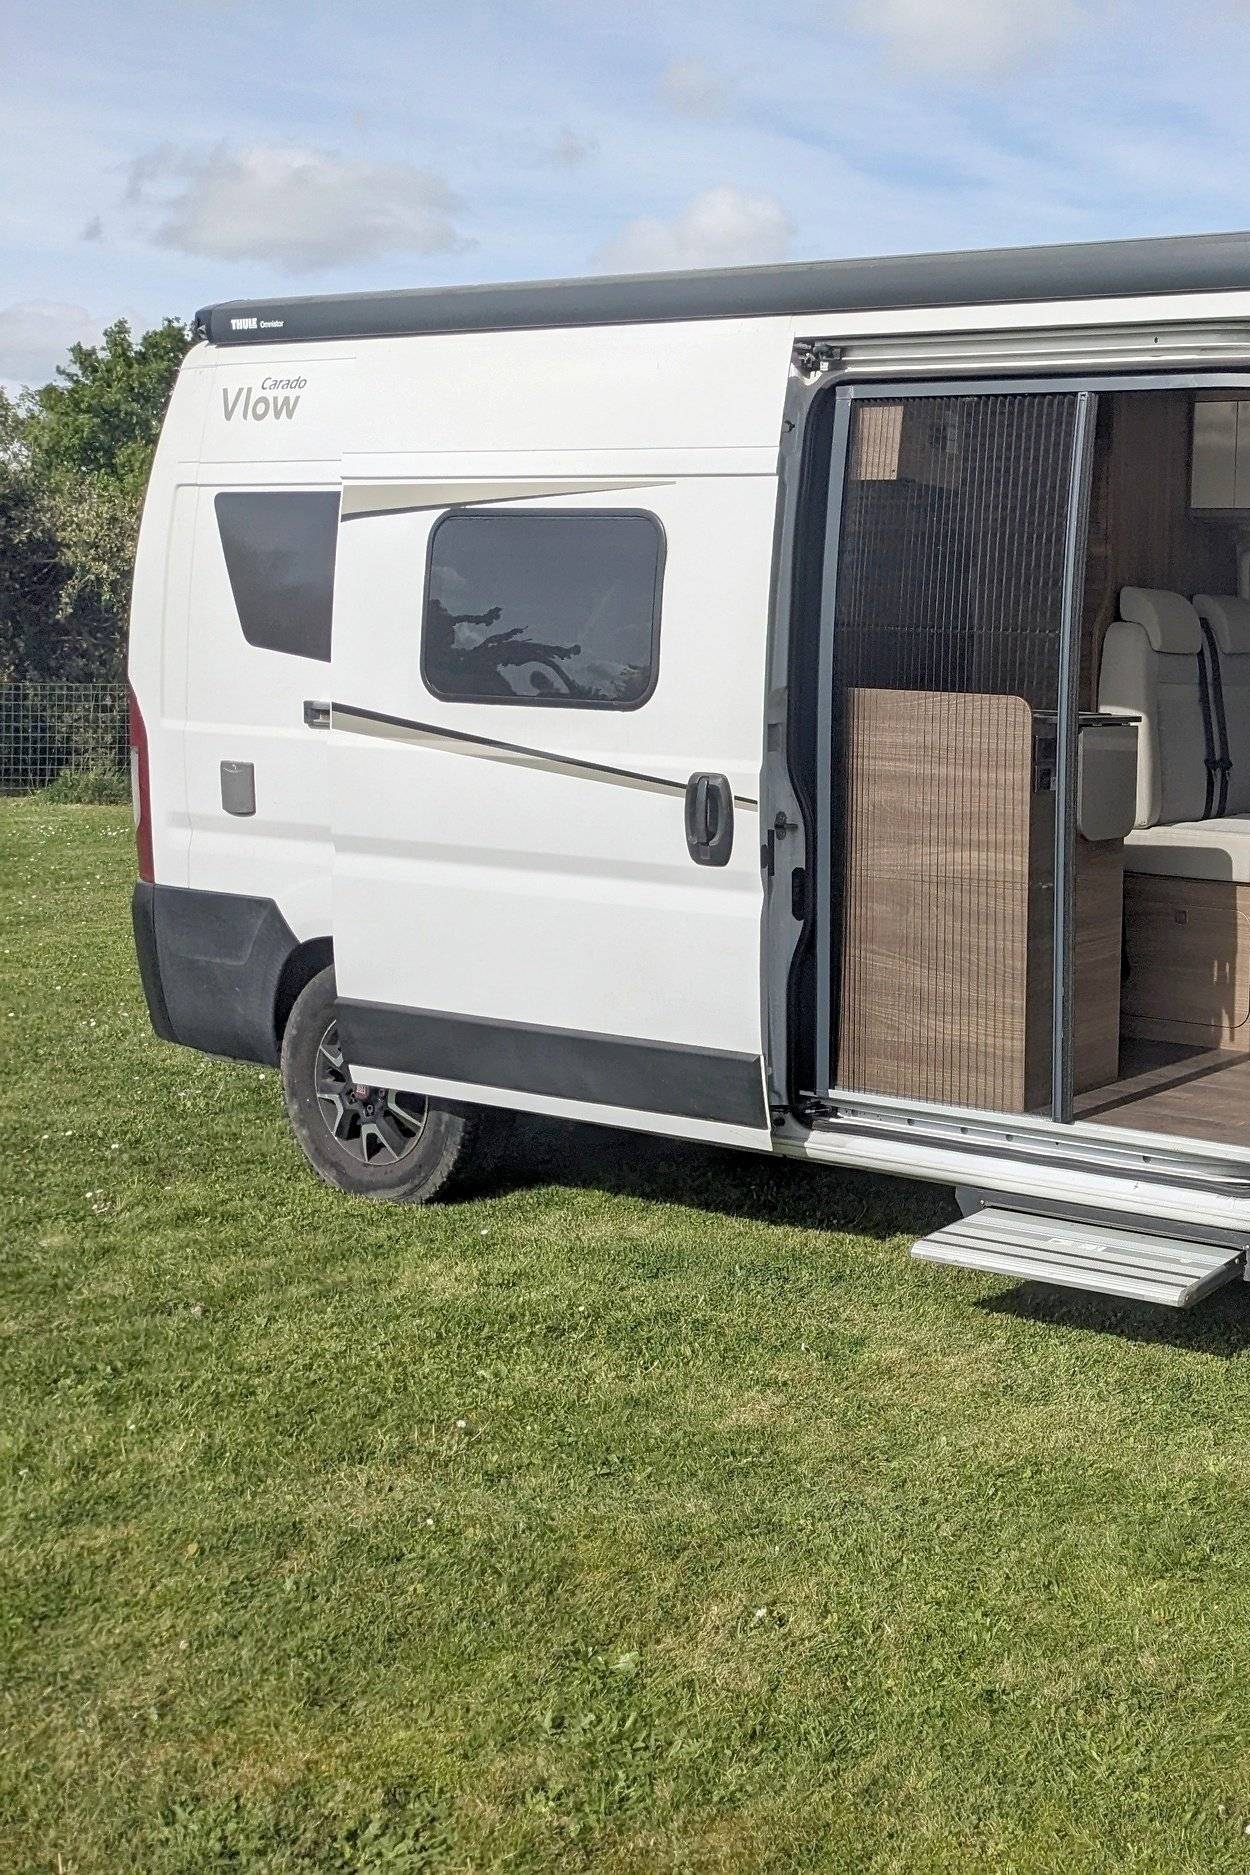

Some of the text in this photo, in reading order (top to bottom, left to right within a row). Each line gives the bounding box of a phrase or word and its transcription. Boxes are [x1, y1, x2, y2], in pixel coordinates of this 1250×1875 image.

[231, 318, 285, 330] THULE Omnistor
[261, 376, 307, 391] Carado
[222, 387, 301, 422] Vlow
